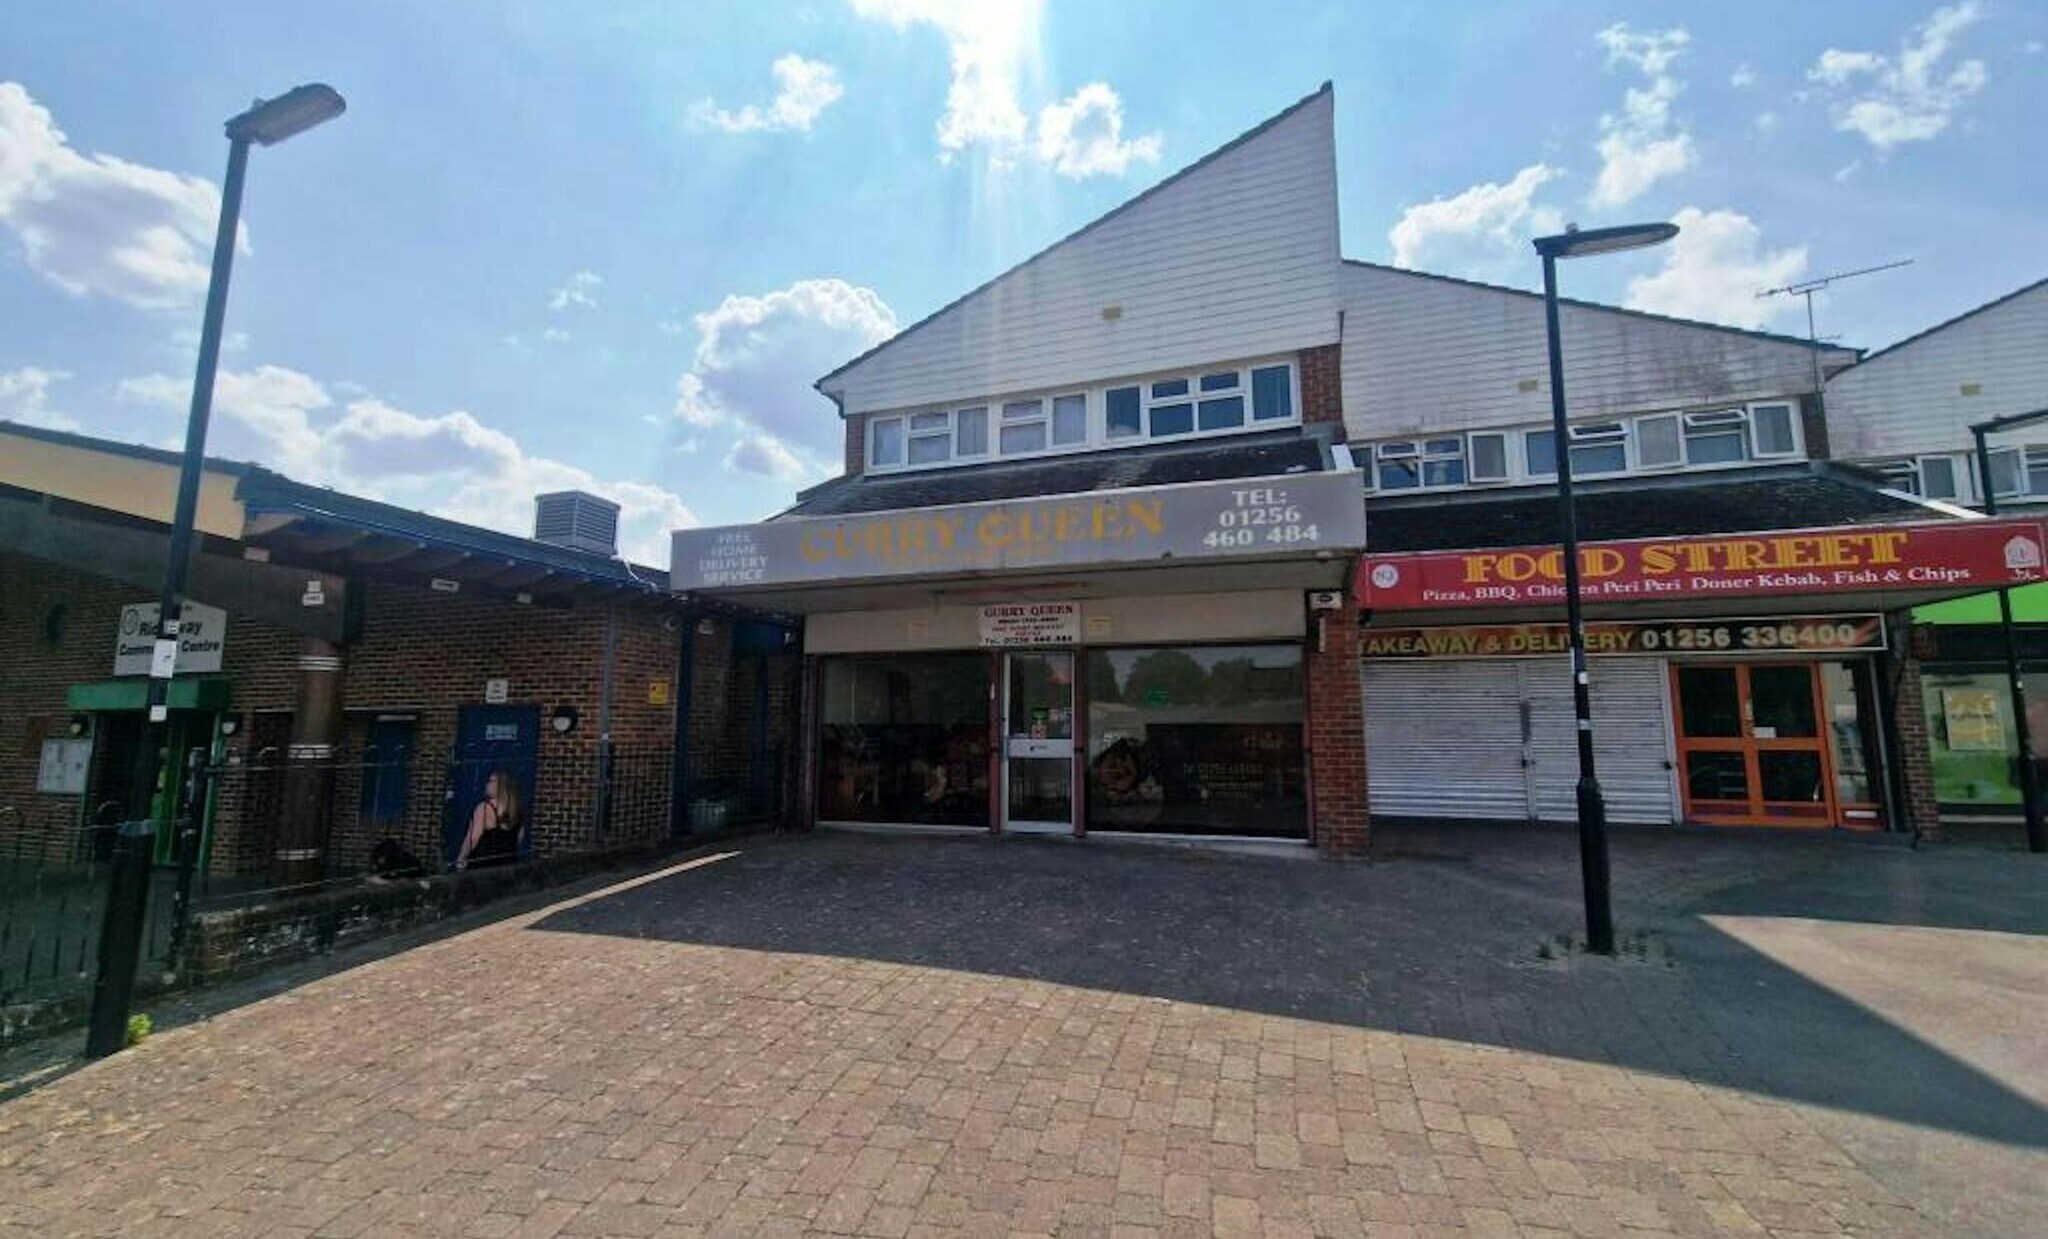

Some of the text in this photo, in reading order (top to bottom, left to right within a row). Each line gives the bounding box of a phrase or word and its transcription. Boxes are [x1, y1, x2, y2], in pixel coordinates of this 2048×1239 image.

[1231, 489, 1287, 507] TEL:
[1219, 504, 1301, 528] 01256
[802, 515, 959, 562] CURRY
[976, 501, 1164, 546] QUEEN
[1202, 523, 1318, 547] 460 484
[709, 543, 759, 556] HOME
[1462, 532, 1908, 582] FOOD STREET
[699, 555, 768, 571] DELIVERY
[1422, 566, 1971, 602] Pizza, BBQ, Chicen Peri Peri Doner Kebab, Fish & Chips
[1486, 634, 1501, 651] &
[1509, 630, 1634, 651] DELIERY
[1641, 627, 1731, 648] 01256
[1742, 624, 1857, 646] 336400
